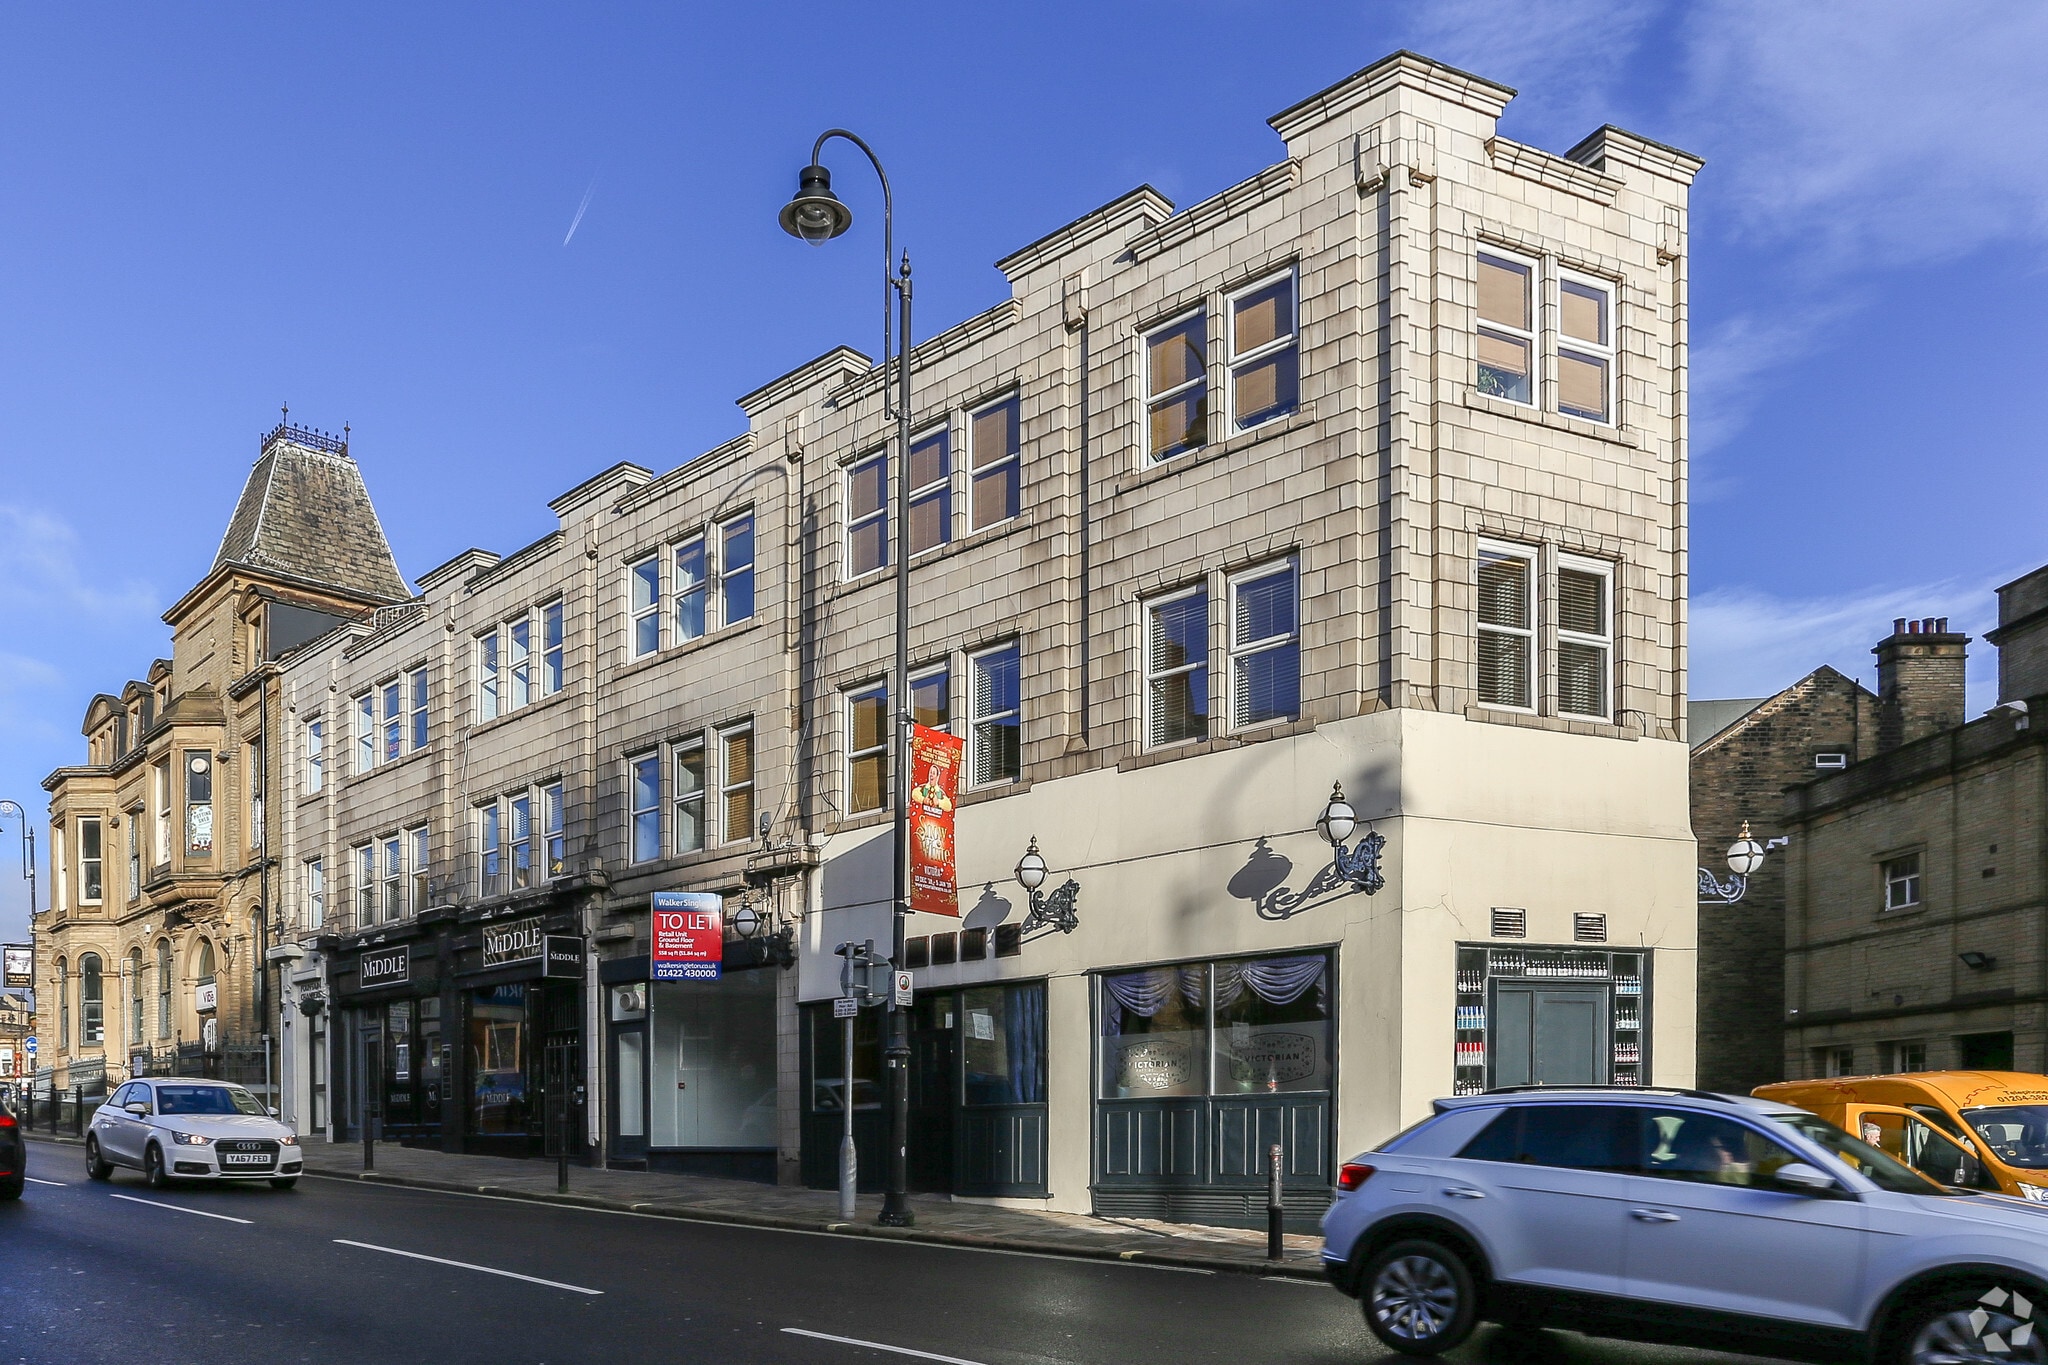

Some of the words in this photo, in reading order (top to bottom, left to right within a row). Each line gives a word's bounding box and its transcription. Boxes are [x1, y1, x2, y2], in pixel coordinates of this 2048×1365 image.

[913, 815, 947, 840] Snow
[659, 913, 684, 930] TO
[688, 914, 714, 929] LET
[657, 962, 716, 970] walkersingleton.co.uk
[657, 969, 683, 977] 01422
[685, 969, 717, 977] 430000
[1244, 1053, 1300, 1063] VICTORIAN
[1129, 1060, 1177, 1069] ICTORIAN
[230, 1155, 251, 1163] YA67
[252, 1155, 268, 1163] FEO
